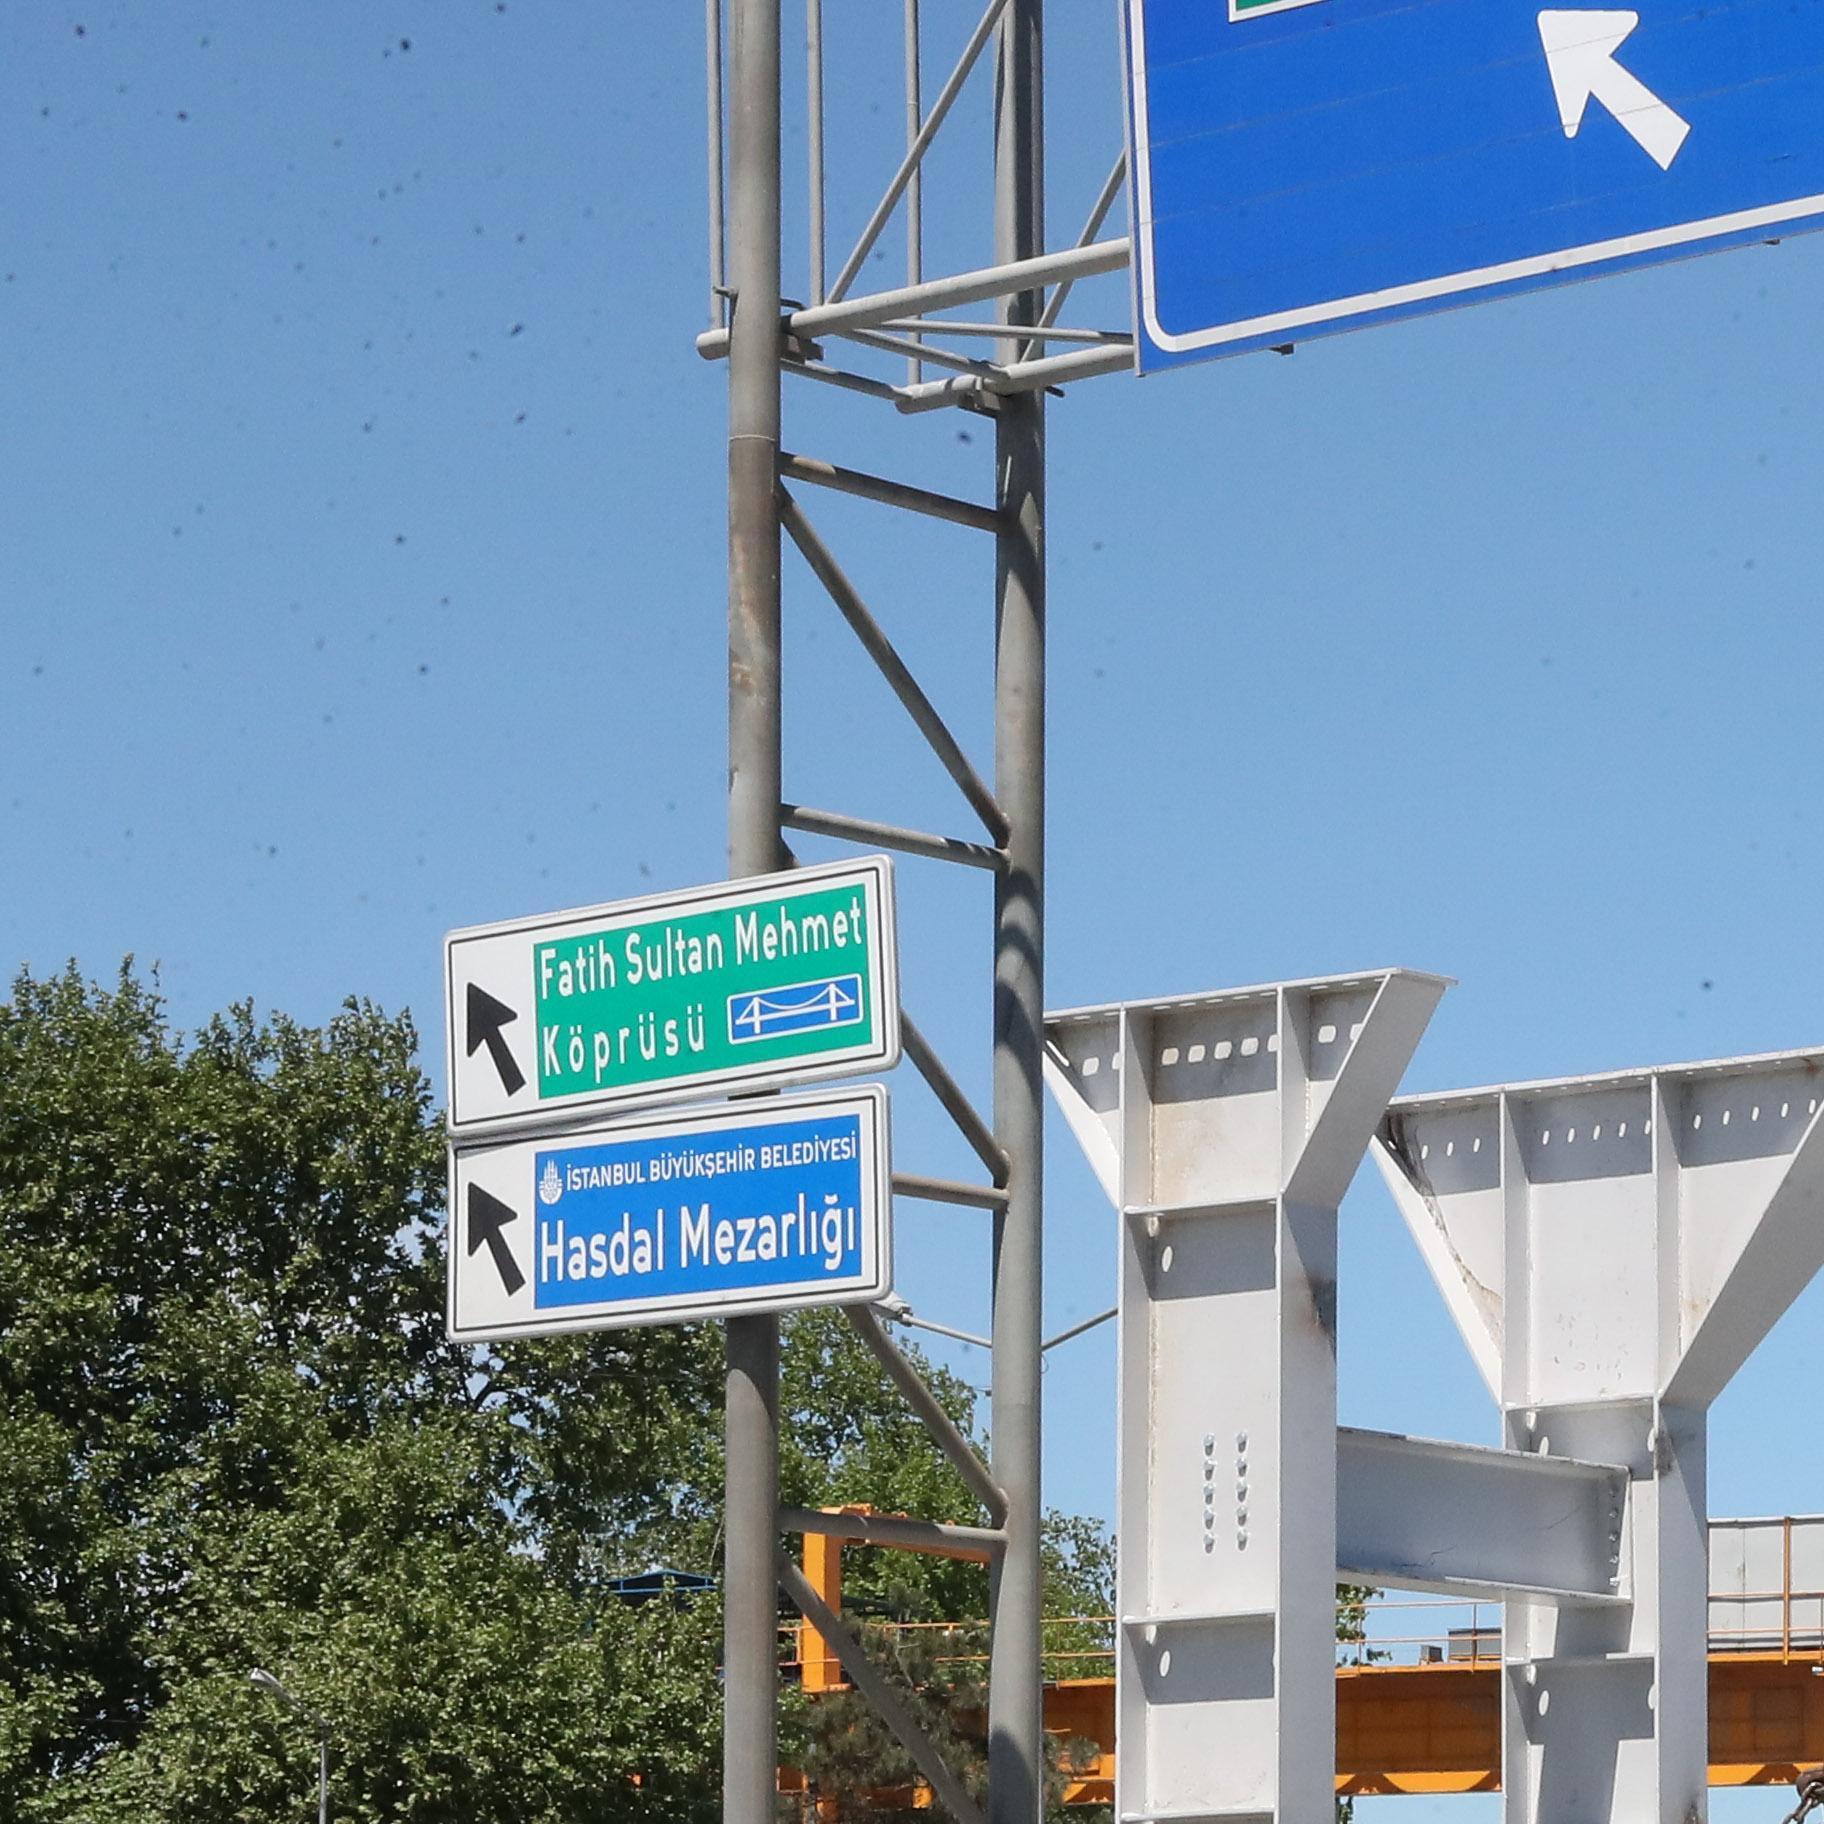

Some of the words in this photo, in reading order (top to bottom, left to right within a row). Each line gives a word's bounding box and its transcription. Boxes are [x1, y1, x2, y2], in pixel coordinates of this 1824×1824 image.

[540, 939, 616, 1000] Fatih
[625, 927, 724, 984] Sultan
[734, 896, 863, 965] Mehmet
[542, 1003, 706, 1084] Köprüsü
[566, 1163, 647, 1191] İSTANBUL
[649, 1144, 756, 1182] BÜYÜKŞEHİR
[760, 1131, 857, 1170] BELEDİYESİ
[541, 1208, 664, 1283] Hasdal
[680, 1193, 855, 1270] Mezarlığı
